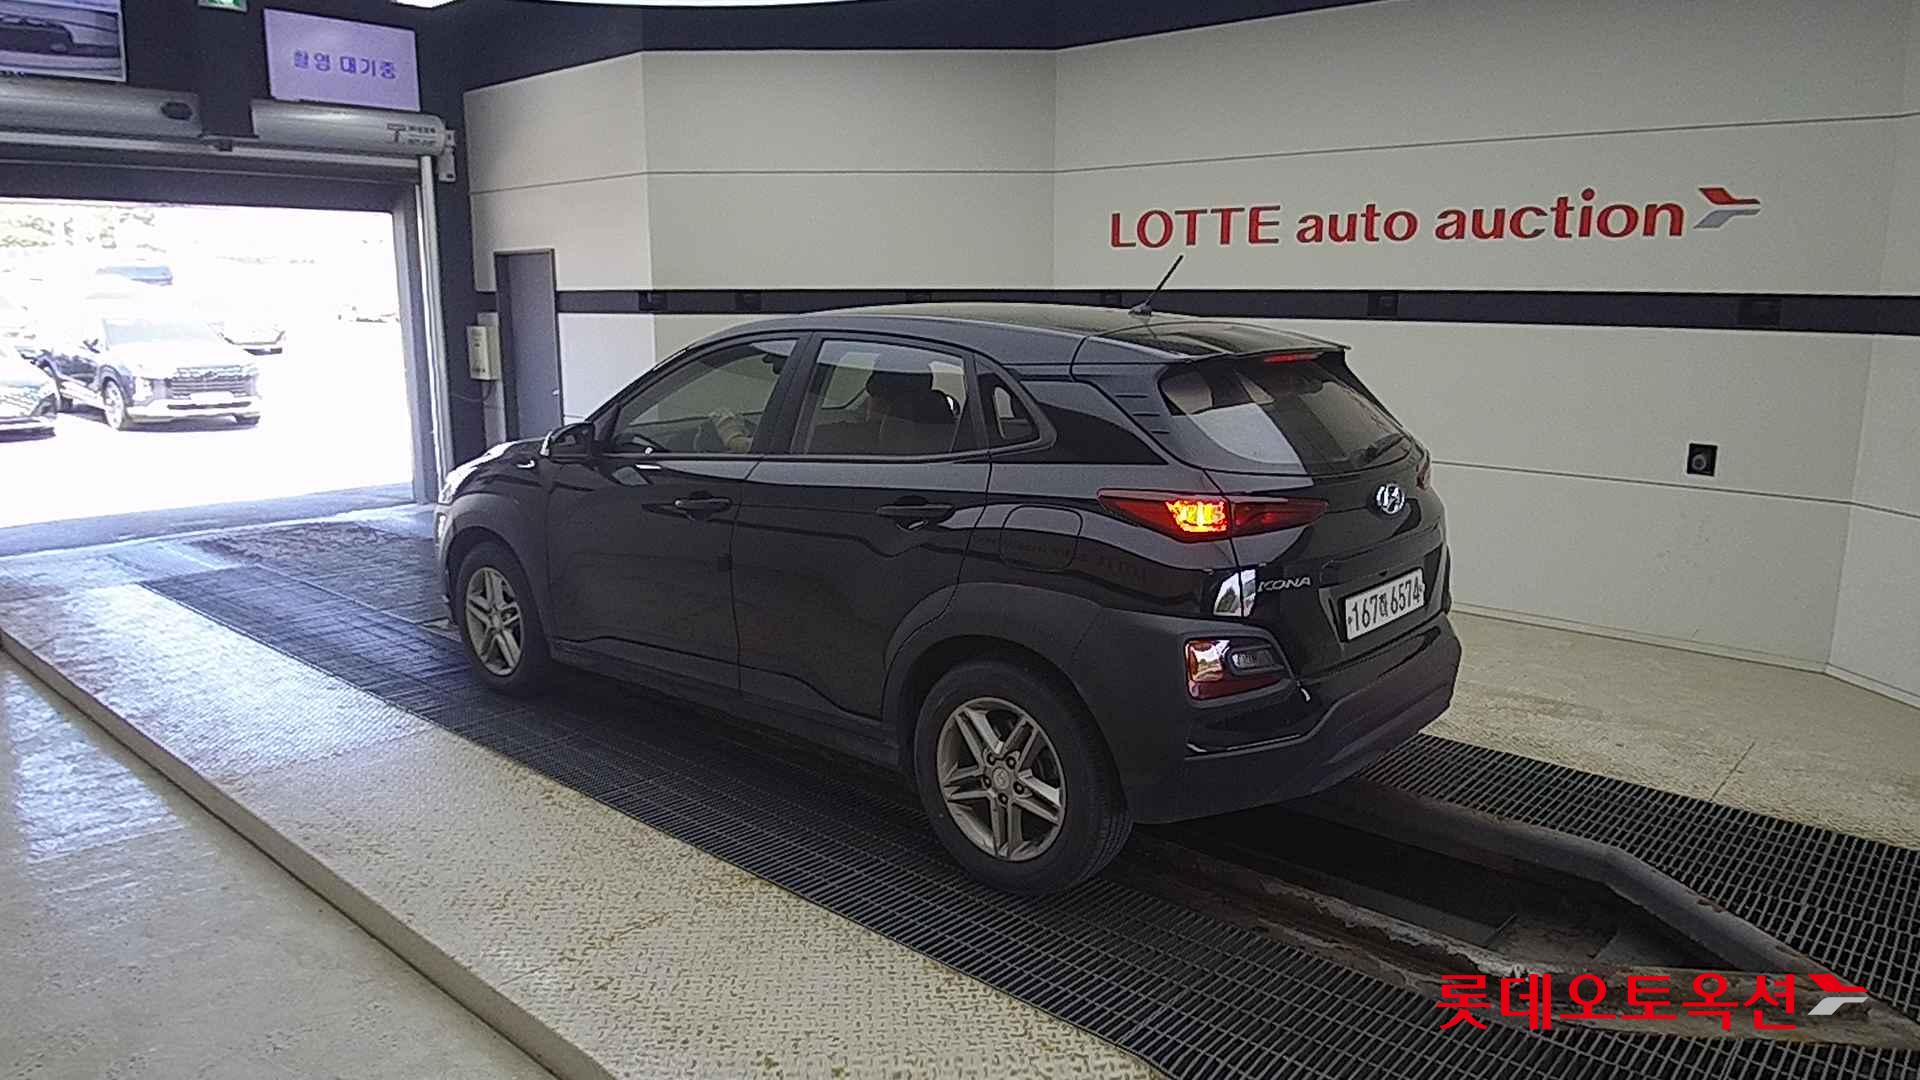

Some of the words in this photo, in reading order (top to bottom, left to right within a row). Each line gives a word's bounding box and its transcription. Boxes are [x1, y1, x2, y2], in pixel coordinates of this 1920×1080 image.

[340, 56, 396, 79] 대기중
[1110, 205, 1281, 248] LOTTE
[1296, 203, 1418, 243] auto
[1435, 187, 1685, 240] auction
[1257, 576, 1311, 592] KONA
